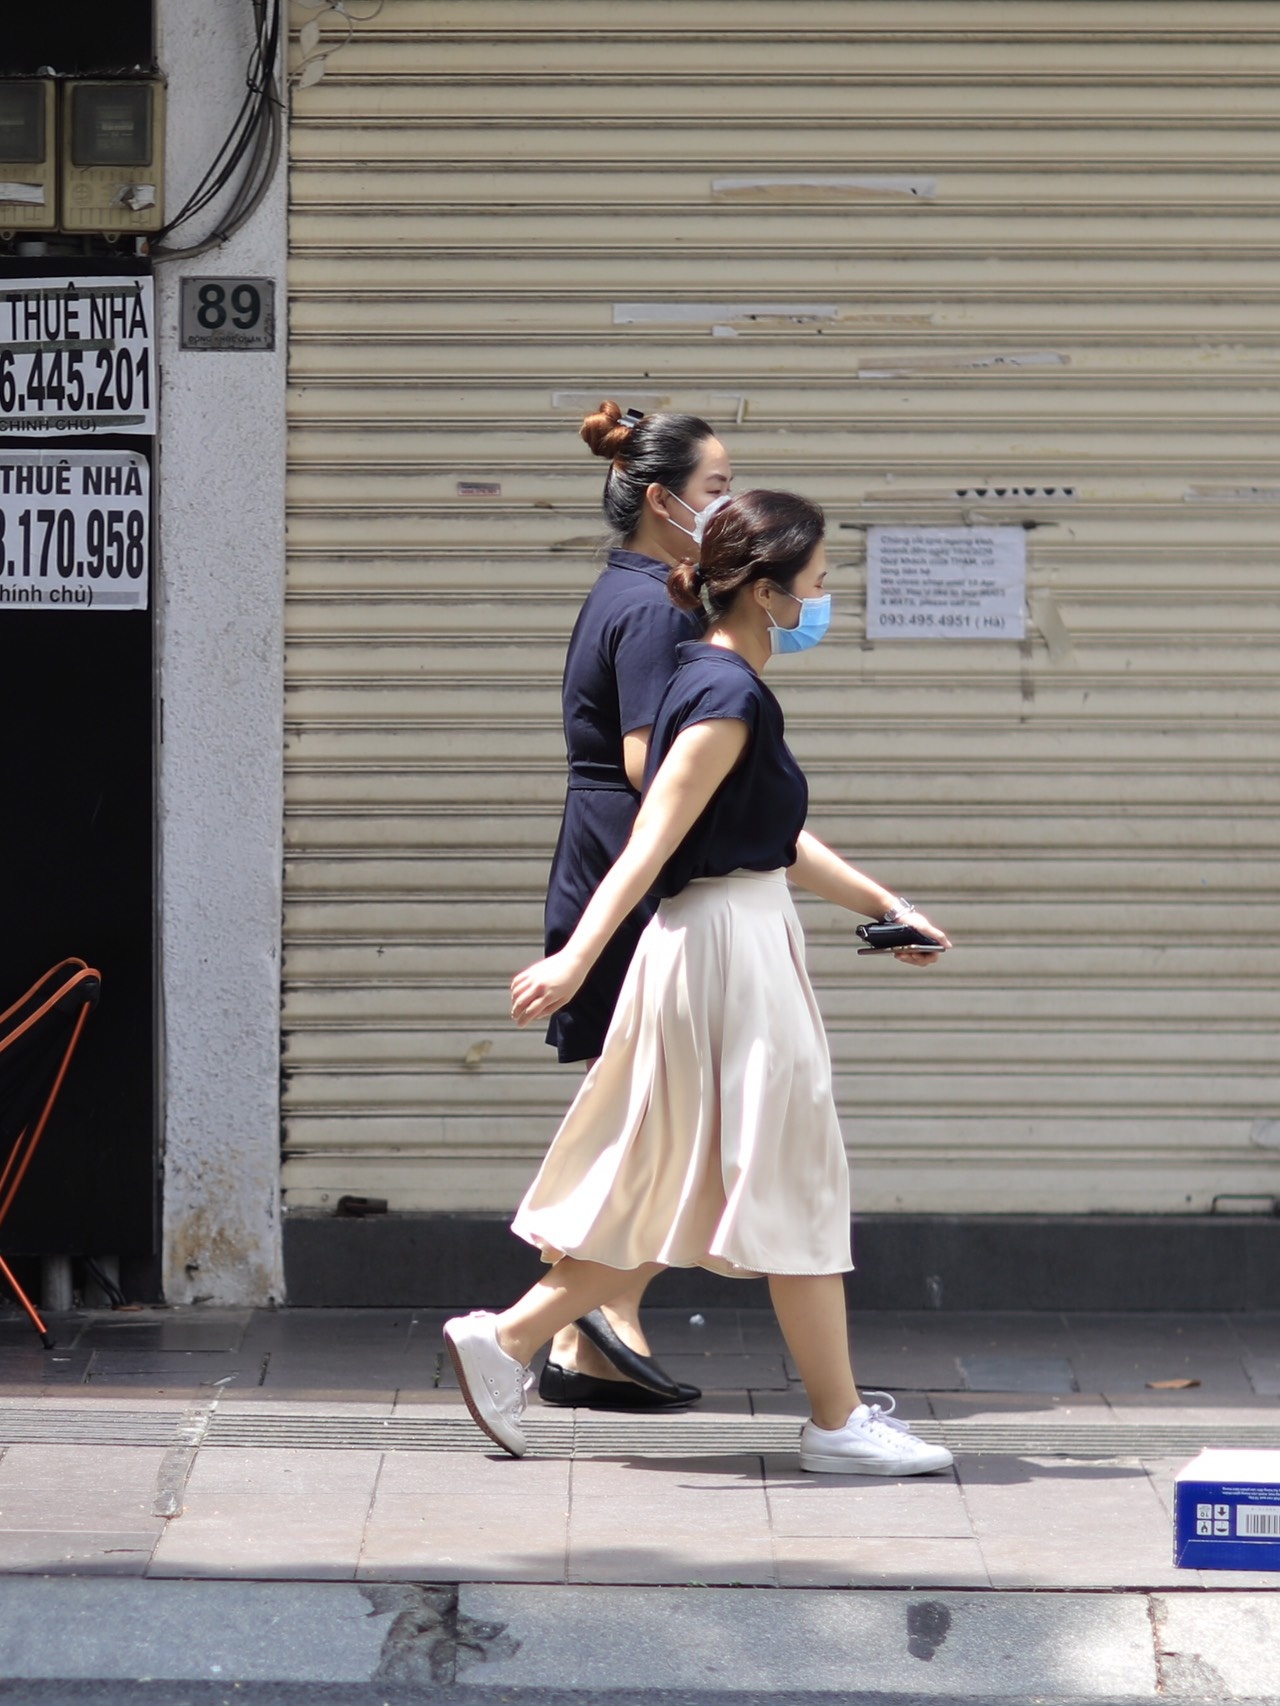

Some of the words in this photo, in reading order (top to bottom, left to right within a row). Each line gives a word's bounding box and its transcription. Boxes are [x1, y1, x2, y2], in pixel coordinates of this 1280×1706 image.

[6, 281, 80, 341] THUÊ
[89, 280, 148, 339] NHÀ
[197, 284, 261, 330] 89
[0, 459, 72, 496] THUÊ
[82, 460, 143, 496] NHÀ
[49, 583, 94, 608] chủ)
